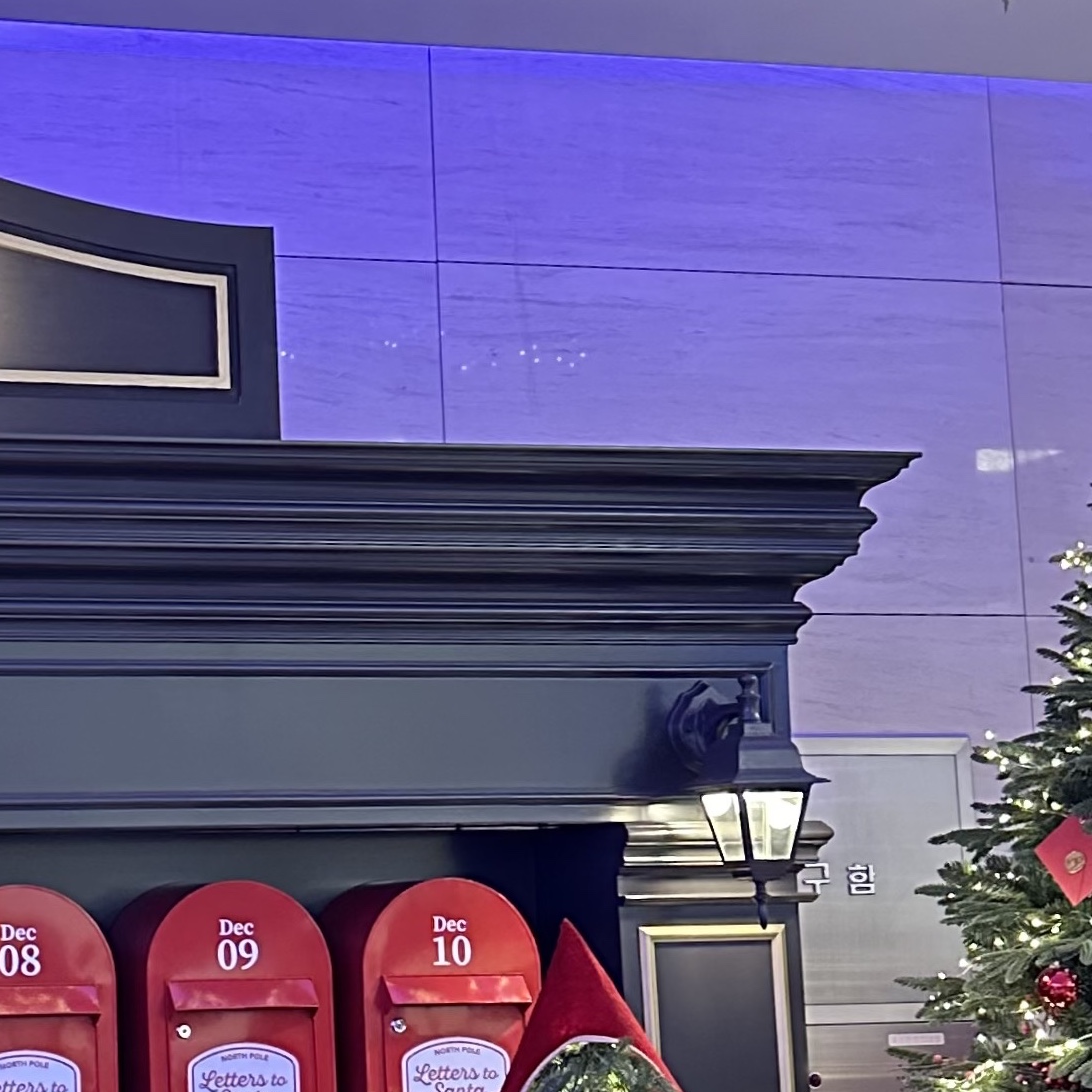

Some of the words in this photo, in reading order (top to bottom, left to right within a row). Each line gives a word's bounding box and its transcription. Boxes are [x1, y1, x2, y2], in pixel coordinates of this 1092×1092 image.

[0, 924, 36, 941] Dec
[219, 919, 253, 936] Dec
[433, 916, 466, 932] Dec
[217, 939, 258, 971] 09
[433, 936, 472, 966] 10
[221, 1053, 247, 1062] NORTH
[250, 1053, 269, 1061] POLE
[434, 1047, 459, 1056] NORTH
[462, 1047, 480, 1055] POLE
[0, 1060, 27, 1070] NORTH
[29, 1060, 49, 1069] POLE
[199, 1071, 268, 1092] Letters
[271, 1073, 287, 1087] to
[413, 1064, 479, 1085] Letters
[483, 1066, 499, 1080] to
